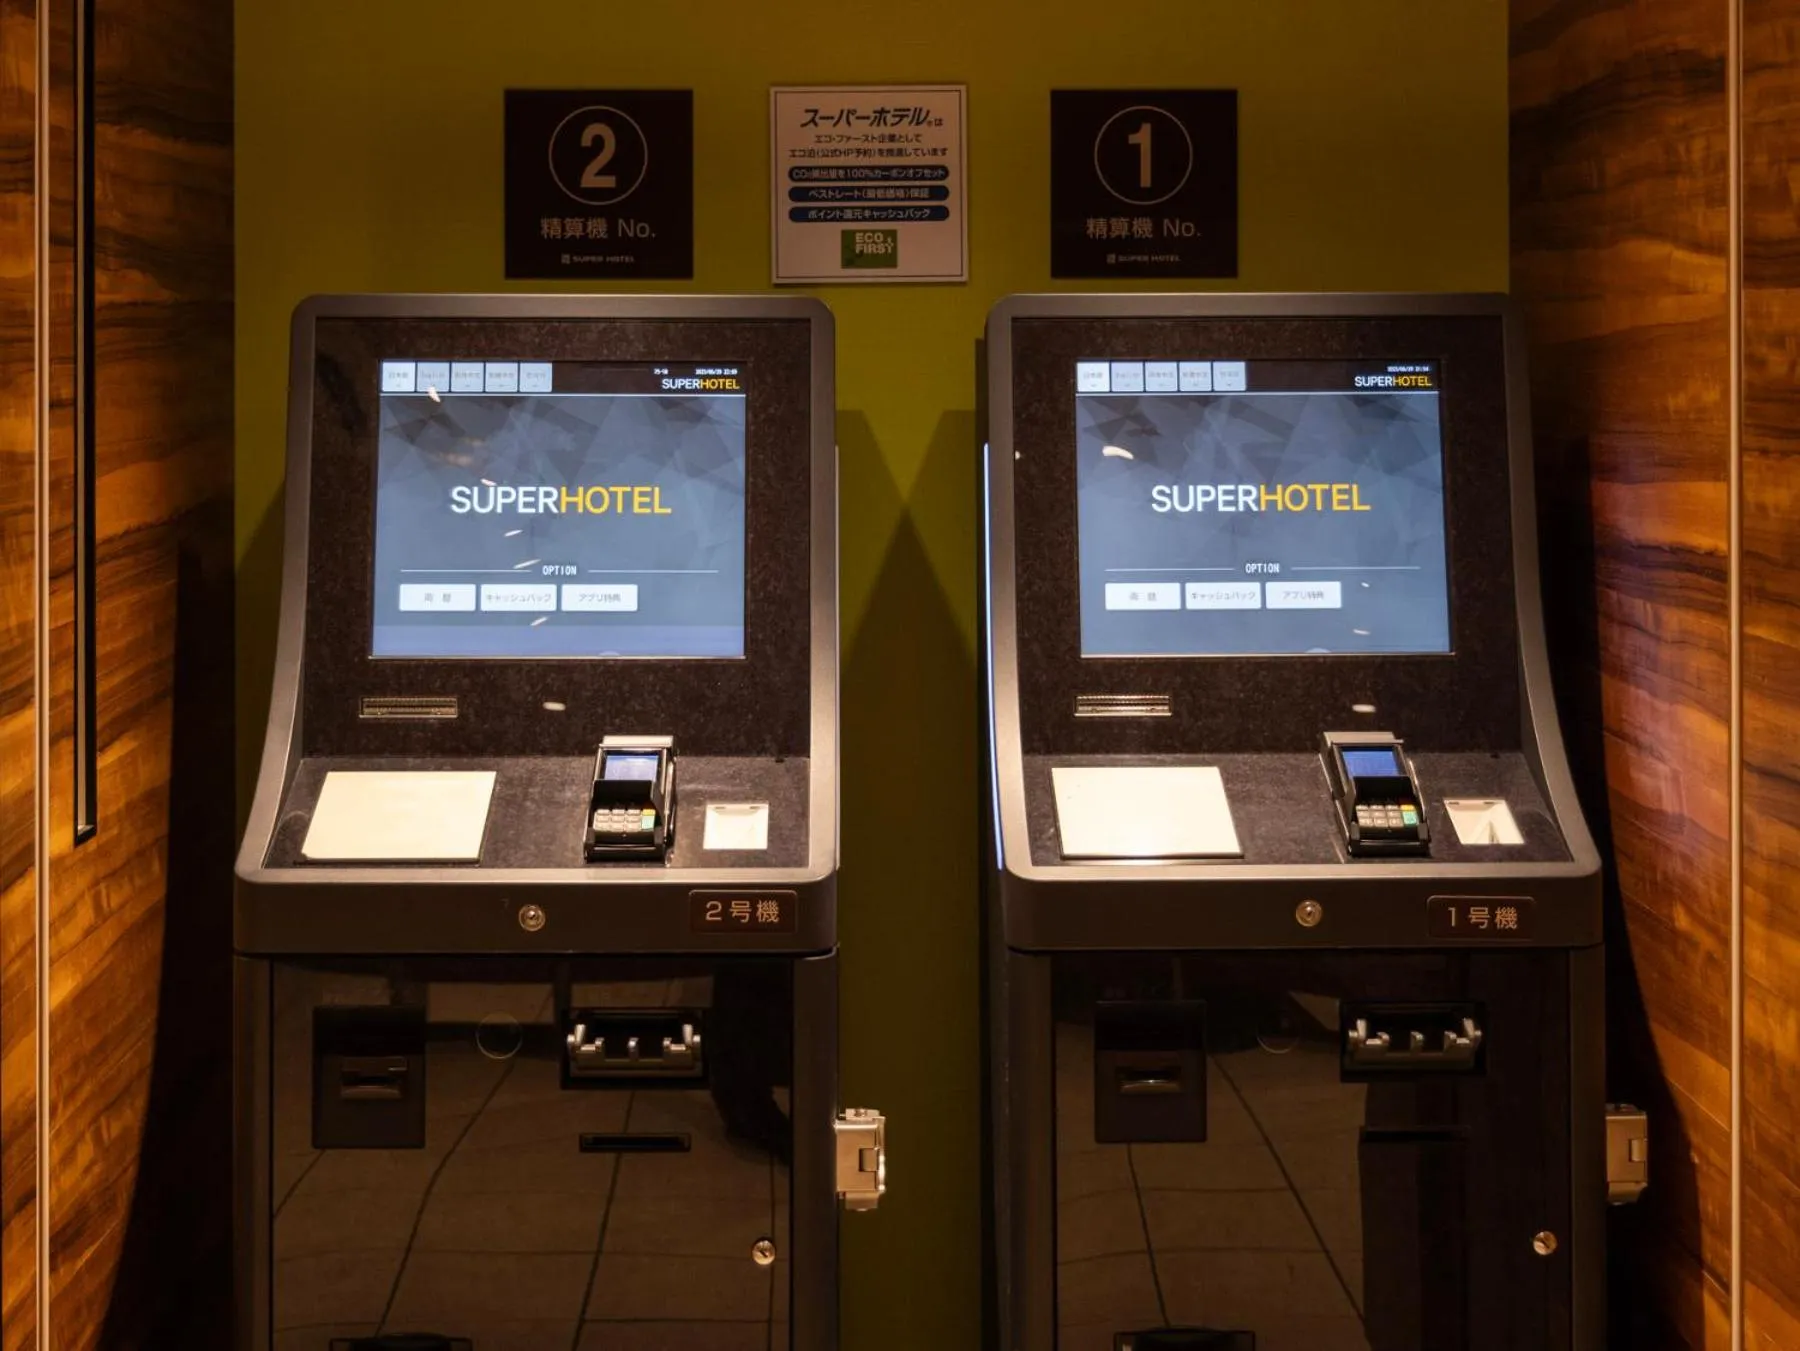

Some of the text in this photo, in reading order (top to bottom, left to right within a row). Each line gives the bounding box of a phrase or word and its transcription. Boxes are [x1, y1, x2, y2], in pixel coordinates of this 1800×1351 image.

[580, 122, 616, 188] 2
[1128, 122, 1151, 188] 1
[541, 217, 657, 239] 精算機 No.
[855, 232, 884, 243] ECO
[1086, 217, 1202, 239] 精算機 No.
[855, 243, 893, 254] FIRST
[662, 378, 740, 389] SUPERHOTEL
[1354, 375, 1432, 387] SUPERHOTEL
[451, 485, 672, 514] SUPERHOTEL
[1151, 483, 1372, 513] SUPERHOTEL
[542, 565, 577, 576] OPTION
[1245, 563, 1280, 574] OPTION
[705, 899, 780, 923] 2号機
[1447, 906, 1518, 929] 1号機
